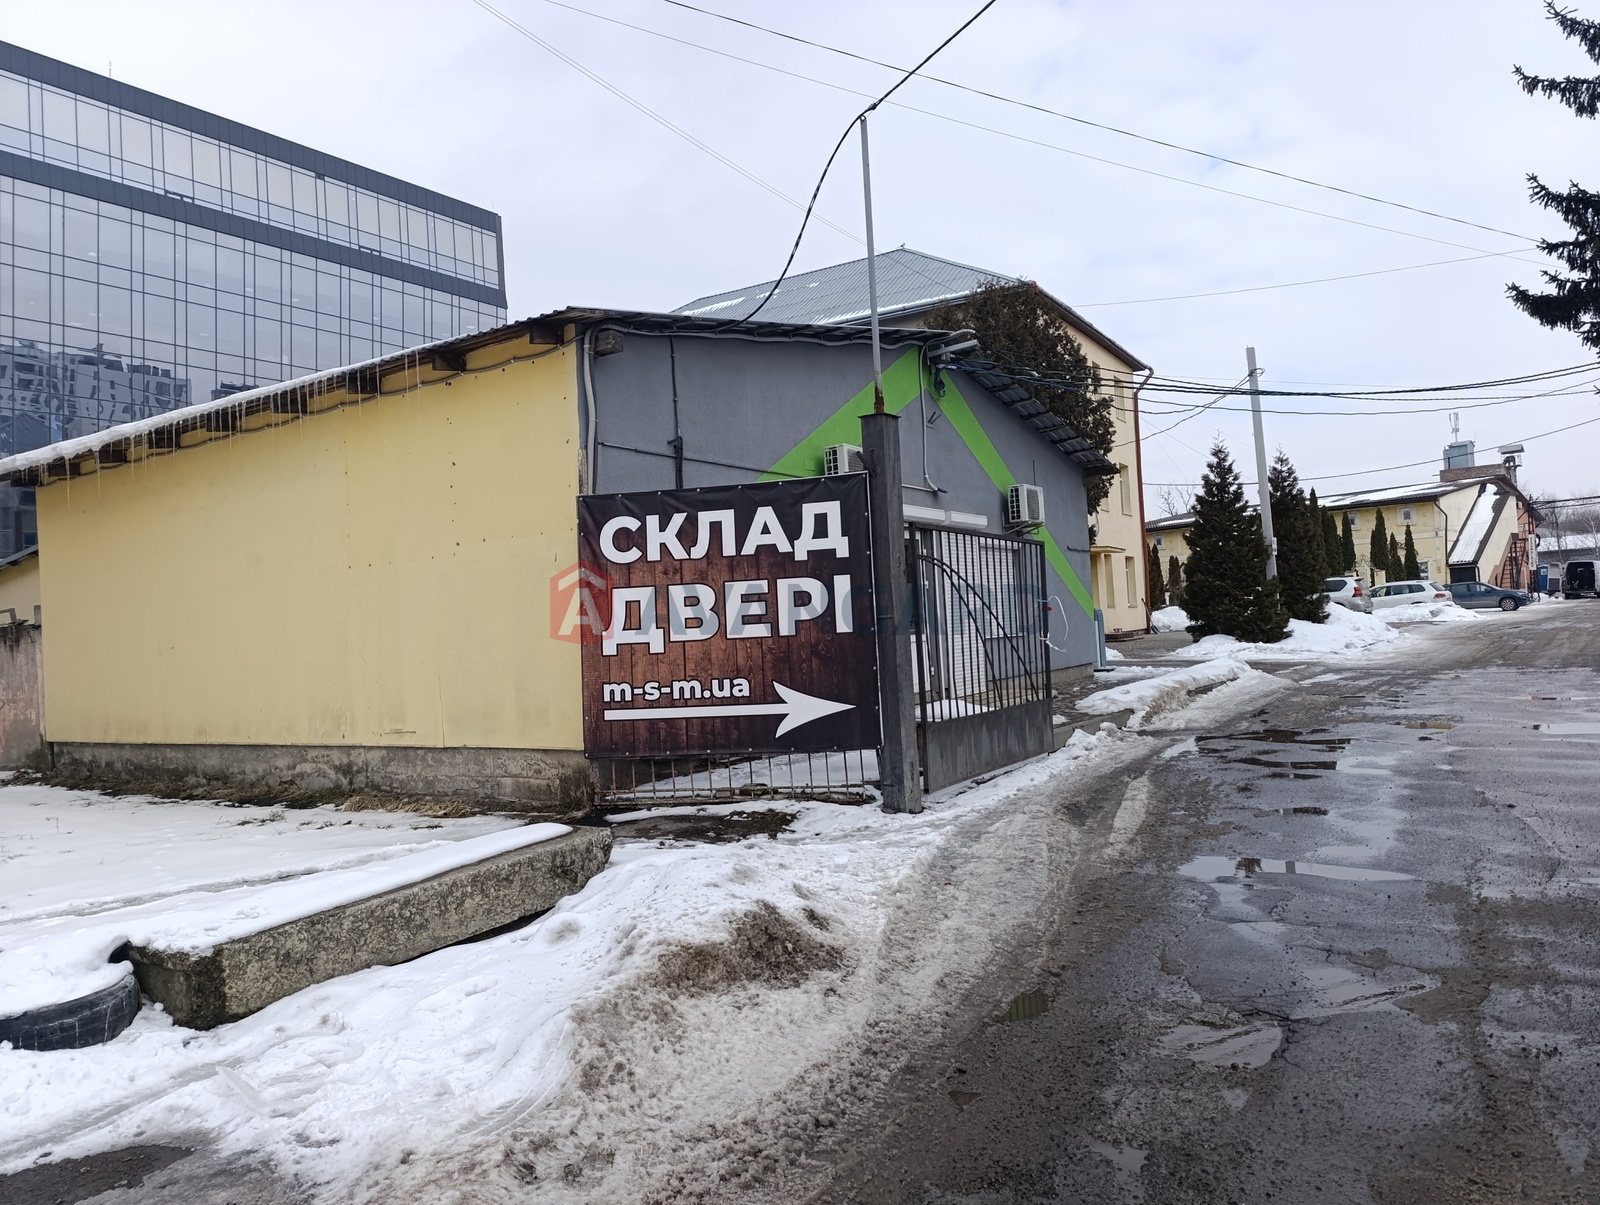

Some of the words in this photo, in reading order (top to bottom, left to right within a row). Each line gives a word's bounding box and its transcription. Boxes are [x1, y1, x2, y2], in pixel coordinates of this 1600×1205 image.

[600, 500, 850, 564] СКЛАД
[602, 574, 853, 656] ДВЕРІ
[603, 677, 750, 702] m-s-m.ua
